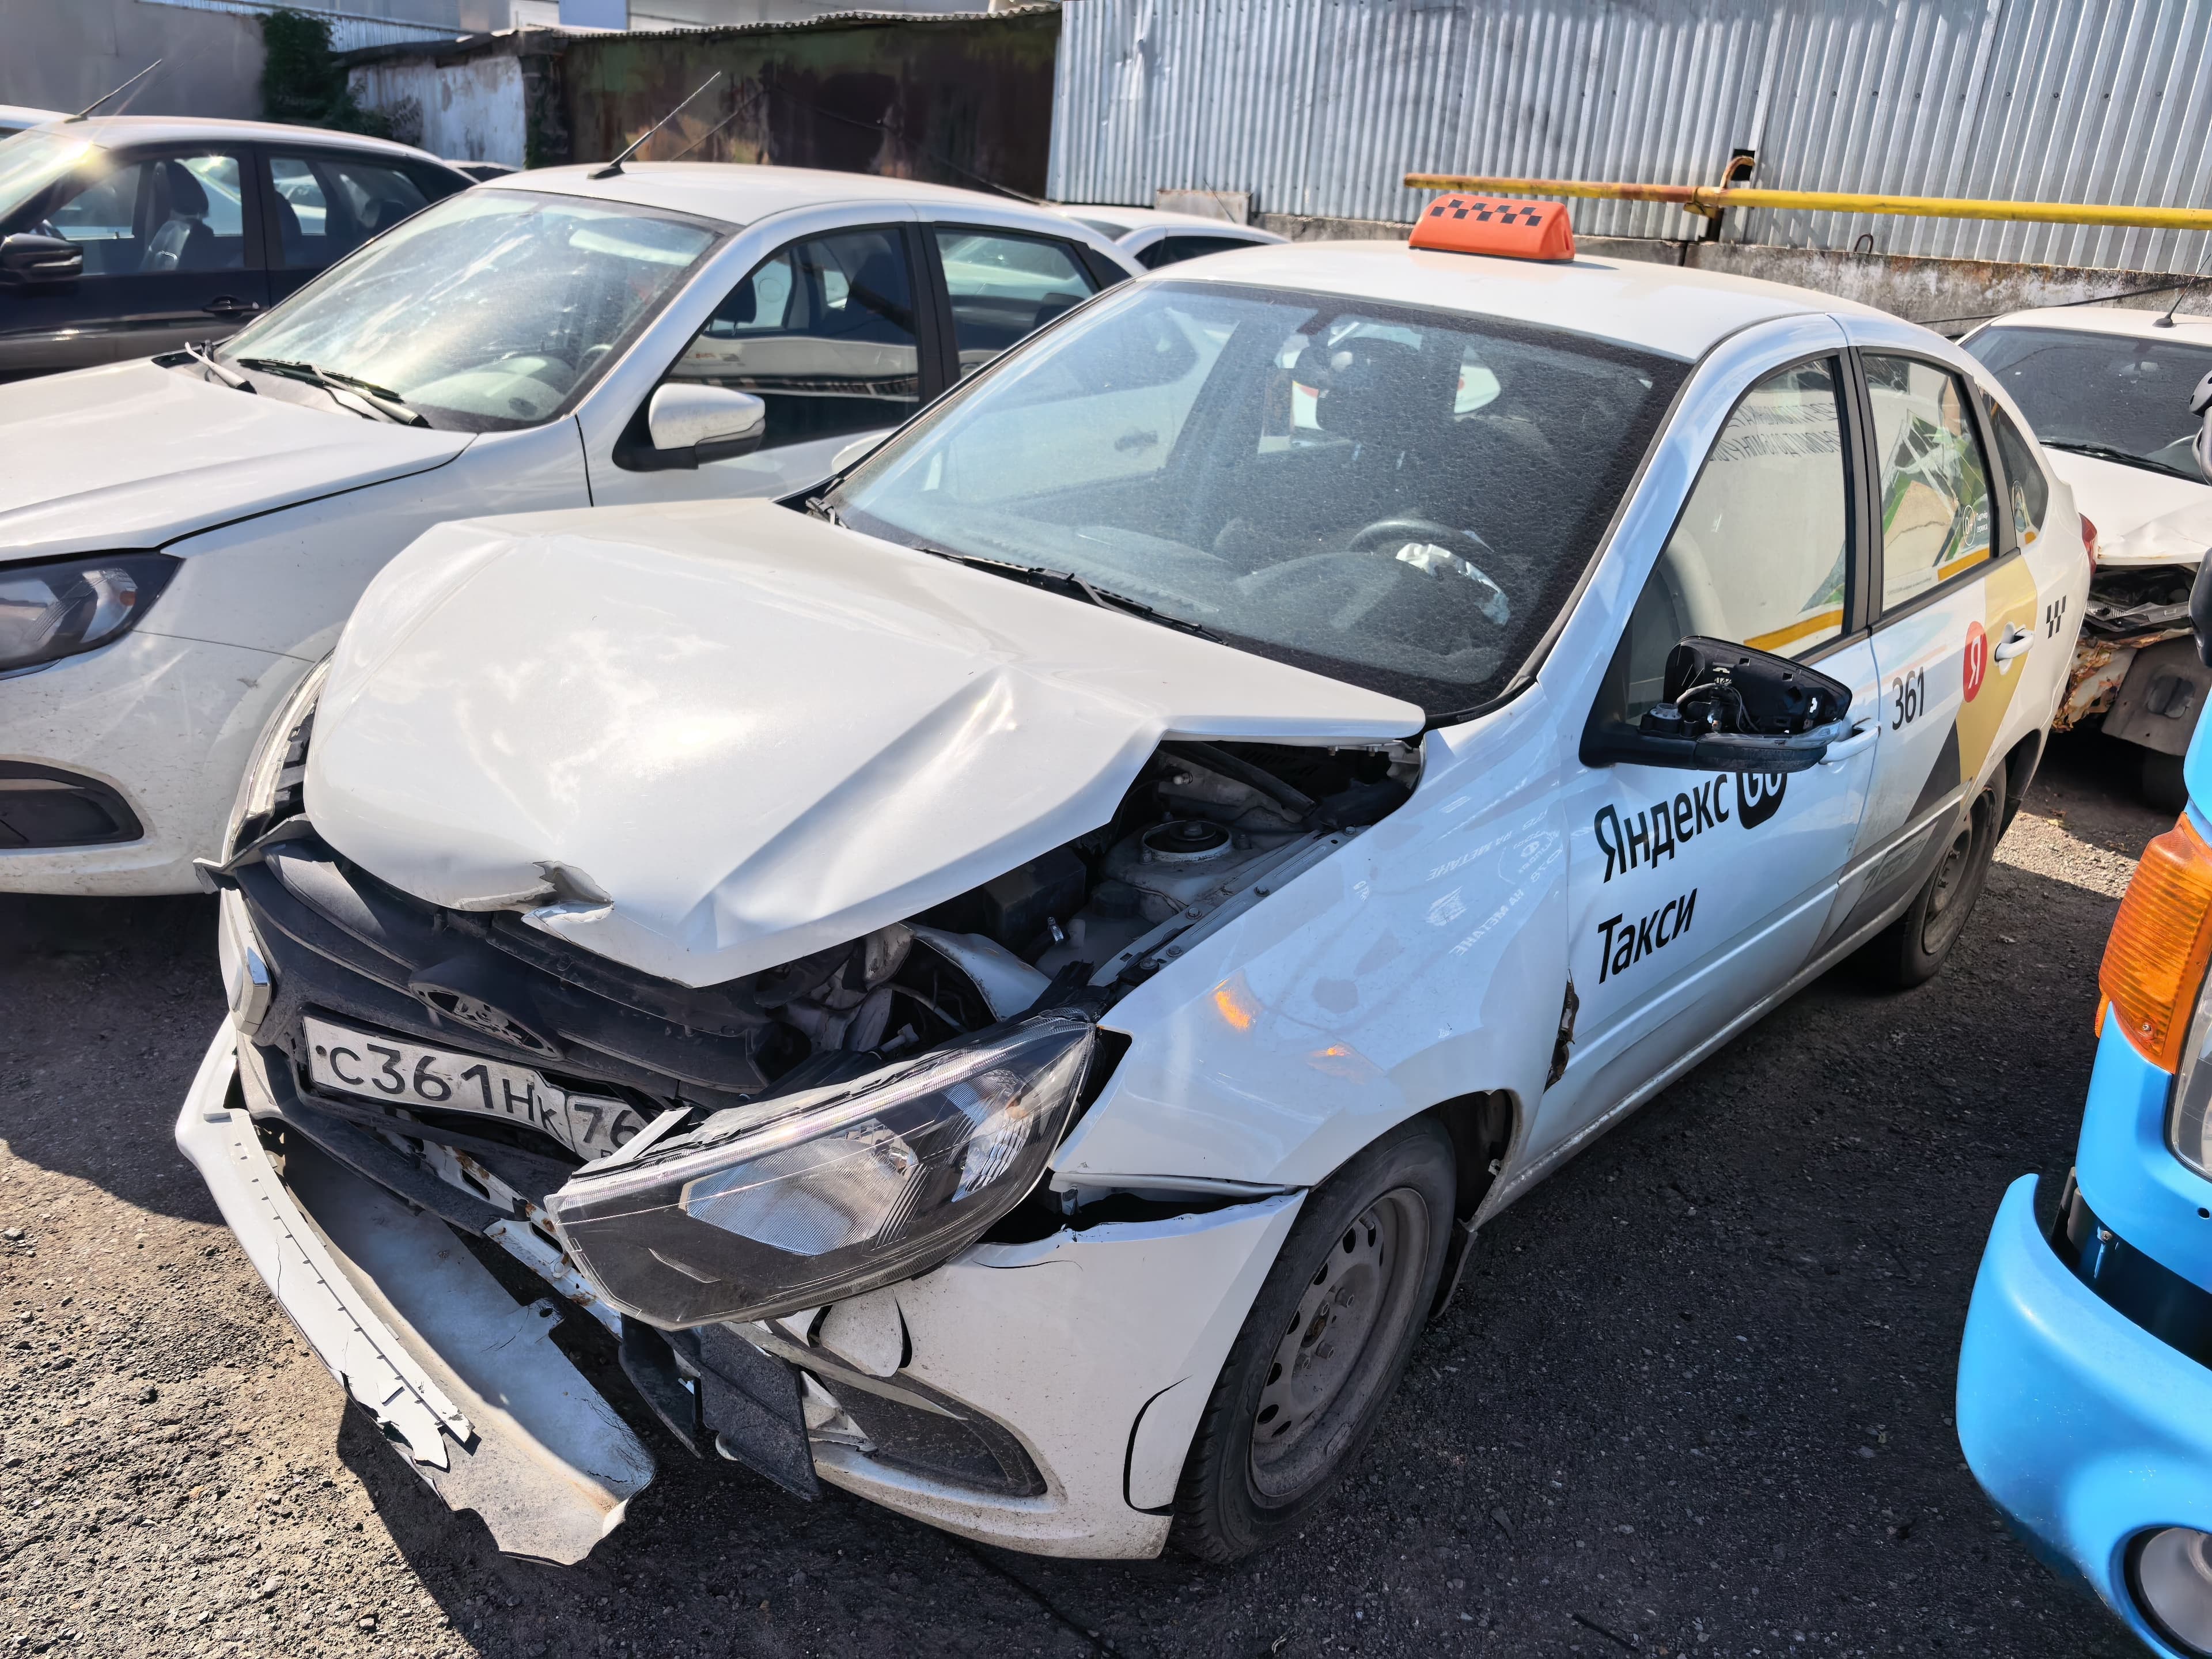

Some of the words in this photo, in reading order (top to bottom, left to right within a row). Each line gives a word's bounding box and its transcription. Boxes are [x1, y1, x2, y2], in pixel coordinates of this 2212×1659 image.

[1892, 666, 1925, 730] 361
[1594, 773, 1729, 883] Яндекс
[1597, 888, 1697, 984] Такси
[573, 1103, 644, 1149] 76
